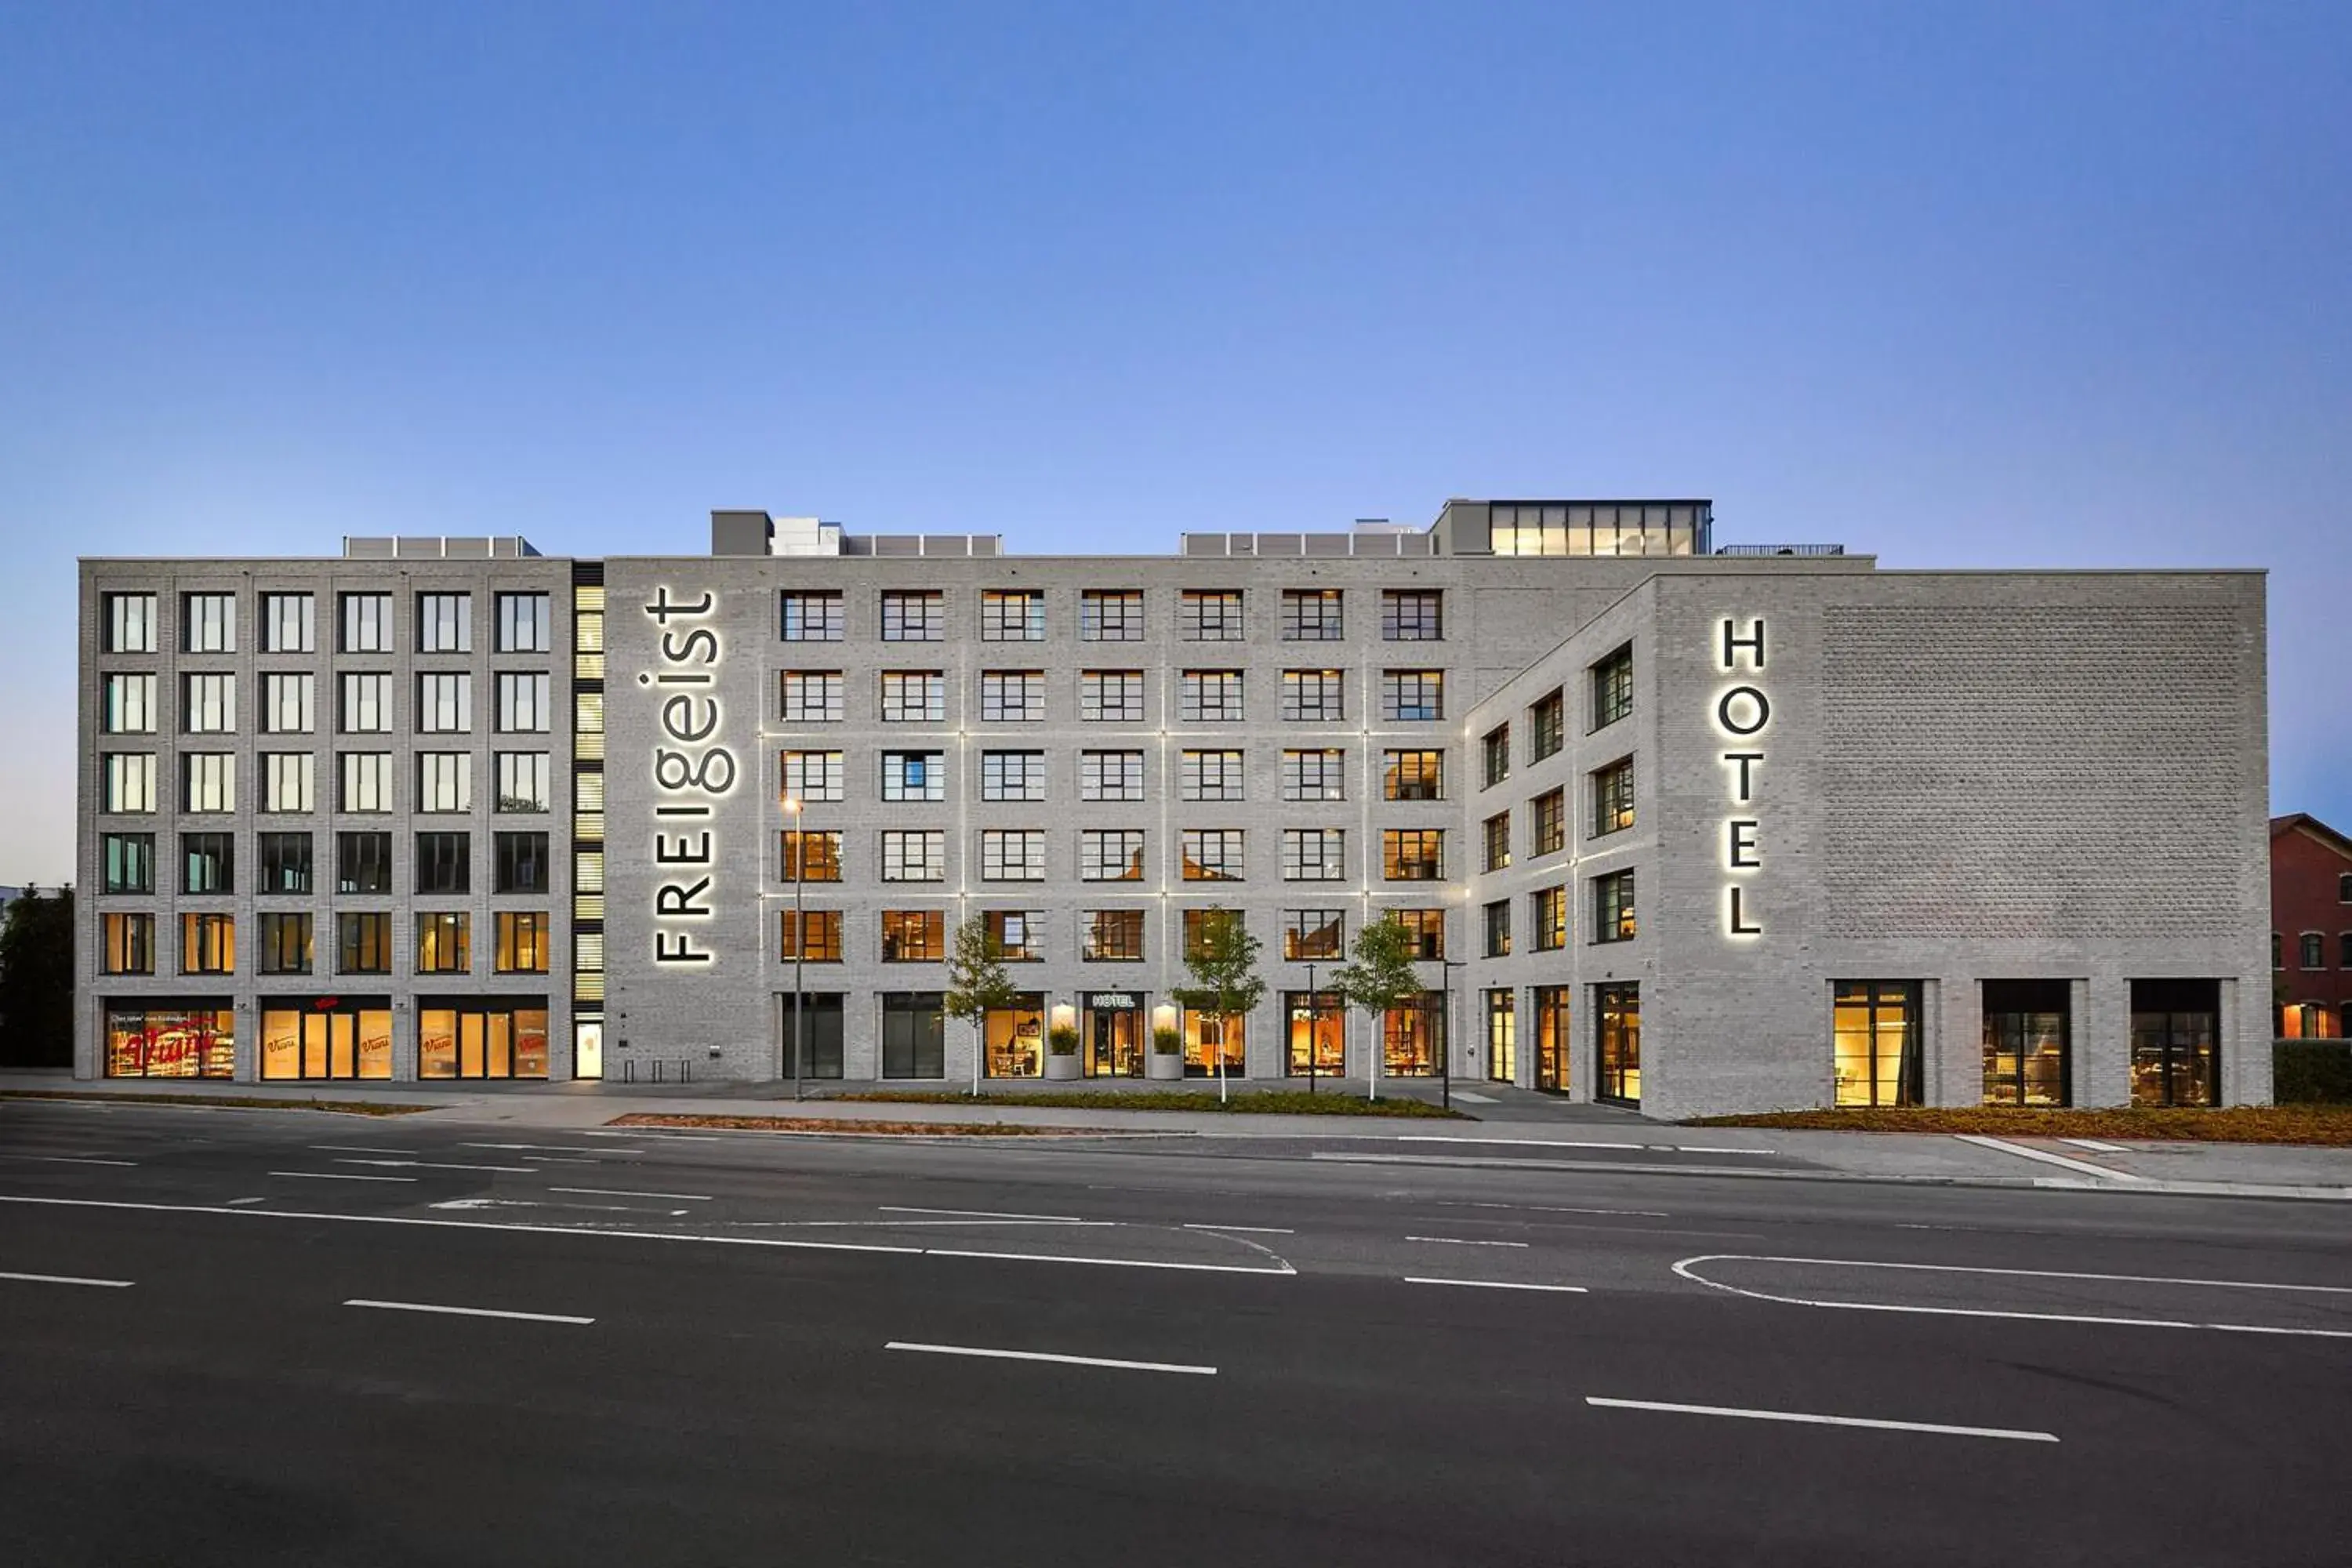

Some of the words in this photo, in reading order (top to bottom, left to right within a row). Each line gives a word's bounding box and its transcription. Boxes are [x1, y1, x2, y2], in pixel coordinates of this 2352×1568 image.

[639, 587, 735, 961] FREIgeist
[1719, 619, 1770, 934] HOTEL
[1092, 994, 1135, 1007] HOTEL
